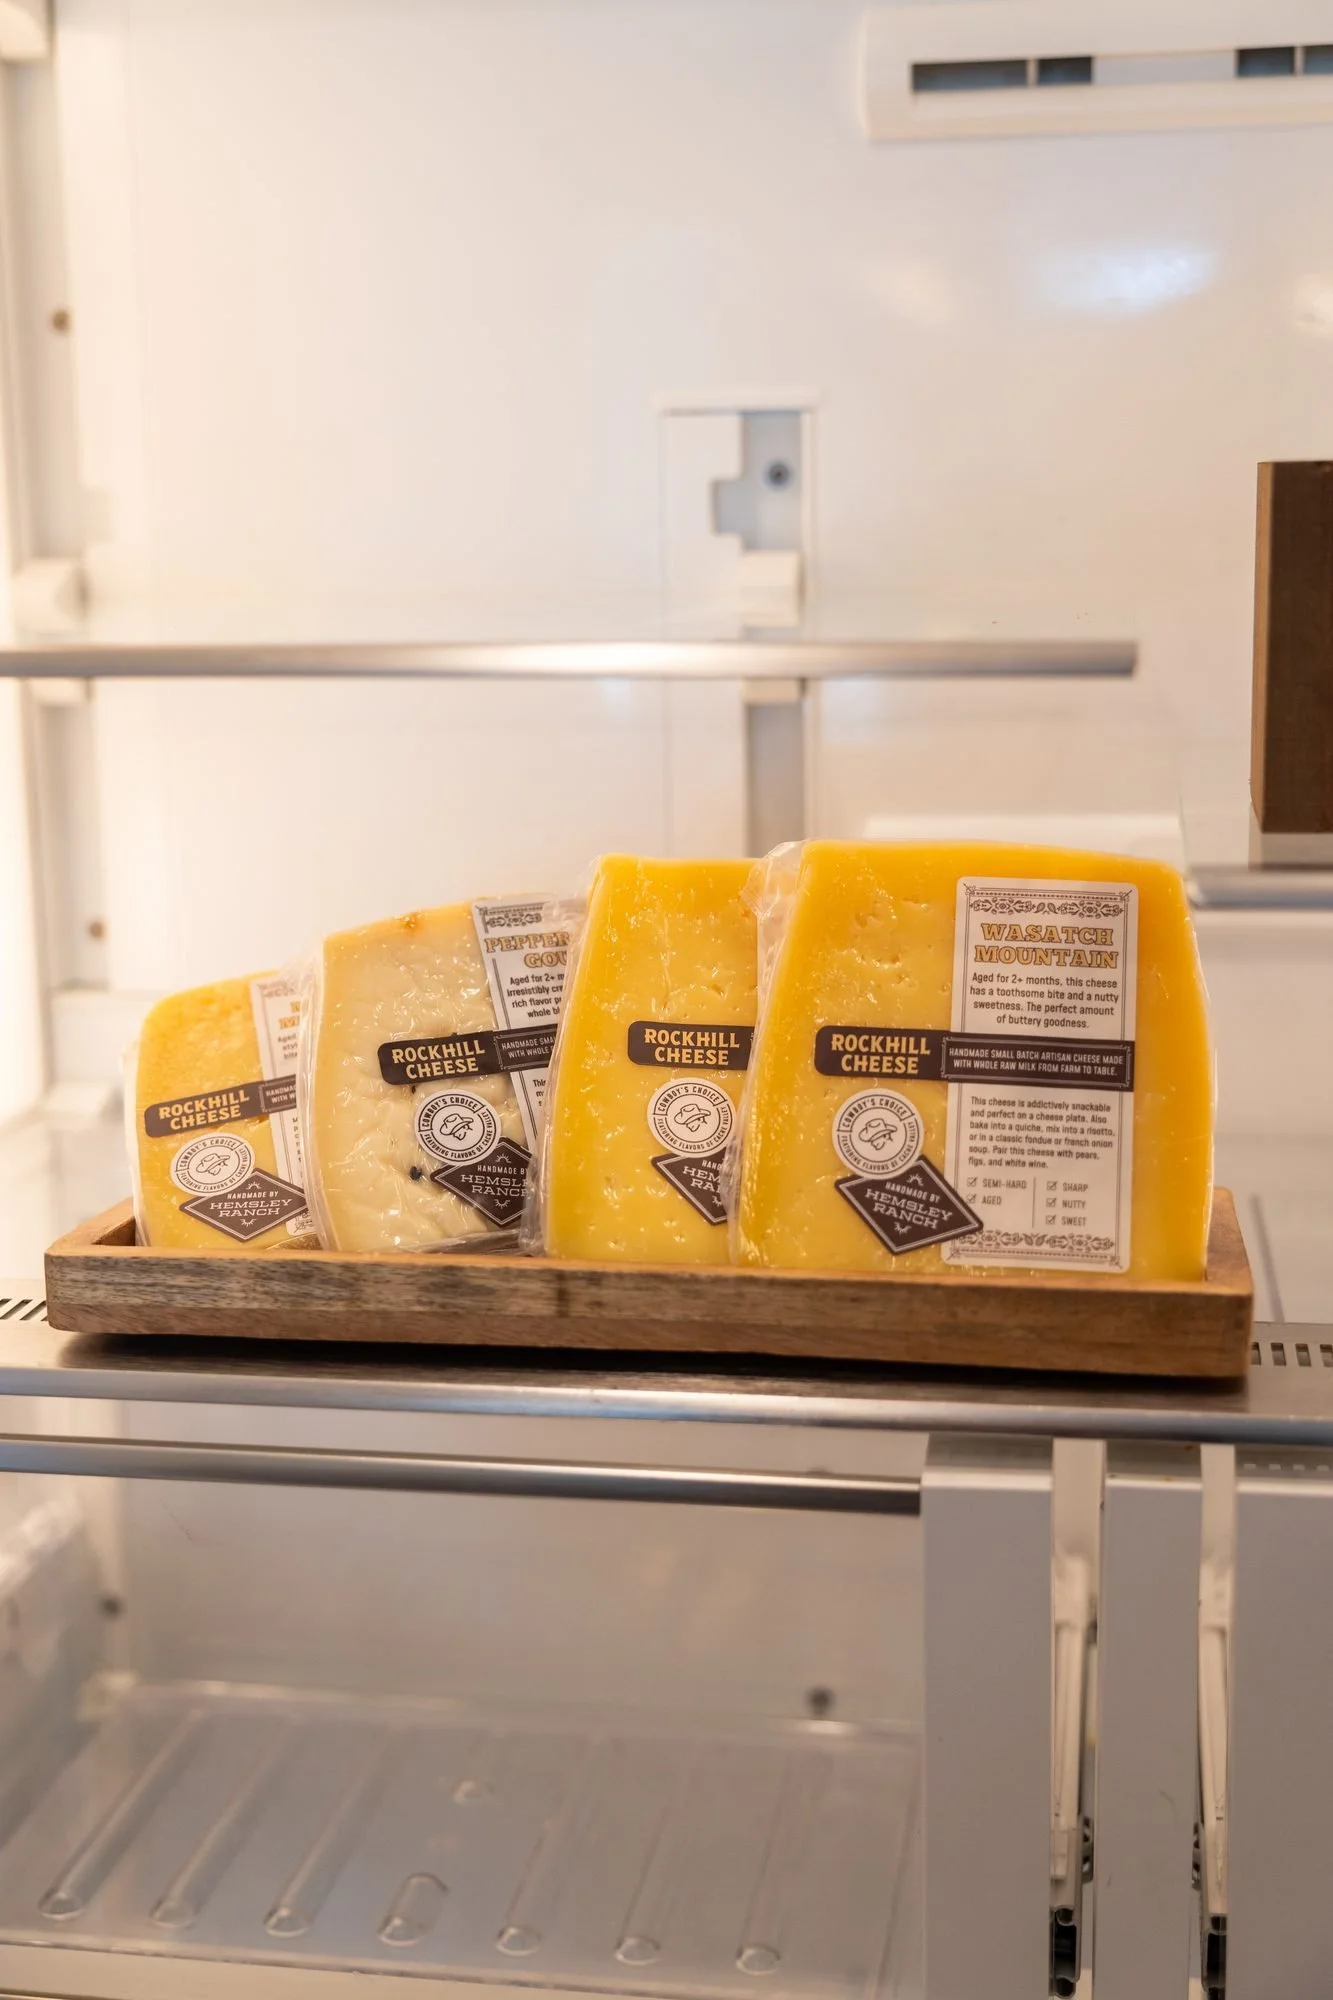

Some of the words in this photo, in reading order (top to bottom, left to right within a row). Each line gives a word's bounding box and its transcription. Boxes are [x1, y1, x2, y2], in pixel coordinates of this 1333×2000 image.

[484, 931, 569, 953] PEPPER
[981, 923, 1113, 946] WASATCH
[524, 951, 567, 968] GOU
[974, 945, 1119, 969] MOUNTAIN
[510, 975, 529, 985] Aged
[972, 973, 993, 983] Aged
[997, 974, 1009, 983] for
[1011, 975, 1022, 983] 2+
[1066, 978, 1083, 987] this
[1086, 979, 1117, 988] cheese
[512, 1000, 527, 1008] rich
[530, 998, 551, 1006] flavor
[970, 987, 985, 995] has
[997, 989, 1044, 998] toothsome
[1048, 990, 1064, 1000] bite
[1068, 992, 1083, 1000] and
[1086, 993, 1092, 1001] a
[1094, 993, 1119, 1003] nutty
[527, 1009, 551, 1018] whole
[973, 1002, 1023, 1011] sweetness.
[1027, 1002, 1042, 1012] The
[1045, 1003, 1077, 1014] perfect
[1080, 1006, 1114, 1015] amount
[997, 1015, 1007, 1023] of
[1008, 1015, 1041, 1027] buttery
[1044, 1018, 1089, 1028] goodness.
[502, 1040, 538, 1050] HANDMADE
[539, 1036, 555, 1046] SMA
[645, 1028, 740, 1048] ROCKHILL
[832, 1034, 930, 1055] ROCKHILL
[392, 1040, 485, 1064] ROCKHILL
[508, 1050, 525, 1058] WITH
[527, 1047, 549, 1056] WHOLE
[654, 1047, 729, 1066] CHEESE
[950, 1048, 988, 1057] HANDMADE
[991, 1049, 1014, 1058] SMALL
[1016, 1051, 1039, 1060] BATCH
[1041, 1052, 1071, 1061] ARTISAN
[1074, 1054, 1100, 1063] CHEESE
[1103, 1056, 1123, 1065] MADE
[405, 1058, 478, 1079] CHEESE
[841, 1055, 919, 1074] CHEESE
[954, 1059, 971, 1068] WITH
[973, 1060, 997, 1069] WHOLE
[1000, 1061, 1016, 1070] RAW
[1018, 1063, 1036, 1071] MILK
[1038, 1064, 1058, 1072] FROM
[1061, 1065, 1080, 1074] FARM
[1094, 1067, 1117, 1076] TABLE.
[159, 1090, 250, 1119] ROCKHILL
[657, 1086, 689, 1112] COWBOY'S
[692, 1087, 720, 1103] CHOICE
[971, 1096, 986, 1105] This
[988, 1098, 1016, 1107] cheese
[1027, 1100, 1069, 1111] addictively
[1072, 1102, 1110, 1112] snackable
[170, 1105, 241, 1130] CHEESE
[422, 1097, 448, 1128] COWBOY'S
[450, 1097, 478, 1110] CHOICE
[842, 1098, 878, 1128] COWBOY'S
[879, 1098, 907, 1117] CHOICE
[987, 1111, 1015, 1119] perfect
[1036, 1113, 1063, 1122] cheese
[1091, 1115, 1107, 1123] Also
[657, 1119, 677, 1145] FEATURING
[678, 1142, 704, 1150] FLAVORS
[706, 1139, 714, 1148] OF
[970, 1122, 988, 1130] bake
[991, 1122, 1006, 1130] into
[1046, 1125, 1060, 1133] mix
[1062, 1126, 1077, 1134] into
[423, 1134, 449, 1157] FEATURING
[477, 1144, 484, 1153] OF
[996, 1134, 1022, 1143] classic
[1025, 1135, 1052, 1144] fondue
[1064, 1137, 1089, 1147] french
[1092, 1139, 1112, 1147] onion
[179, 1140, 207, 1168] COWBOY'S
[210, 1138, 237, 1148] CHOICE
[841, 1135, 862, 1166] FEATURING
[862, 1162, 890, 1172] FLAVORS
[891, 1158, 899, 1170] OF
[993, 1146, 1007, 1154] Pair
[1010, 1147, 1024, 1155] this
[1027, 1148, 1054, 1157] cheese
[1057, 1149, 1073, 1158] with
[477, 1165, 517, 1174] HANDMADE
[988, 1158, 1002, 1166] and
[1005, 1159, 1026, 1167] white
[180, 1172, 201, 1190] FEATURING
[203, 1180, 228, 1191] FLAVORS
[230, 1177, 237, 1185] OF
[982, 1179, 1027, 1189] SEMI-HARD
[1063, 1183, 1088, 1192] SHARP
[885, 1182, 927, 1200] HANDMADE
[930, 1194, 940, 1203] BY
[982, 1196, 1002, 1205] AGED
[210, 1199, 292, 1209] HEMSLEY
[218, 1207, 280, 1217] RANCH
[865, 1189, 952, 1221] HEMSLEY
[1062, 1200, 1086, 1209] NUTTY
[873, 1203, 938, 1229] RANCH
[1061, 1217, 1086, 1226] SWEET
